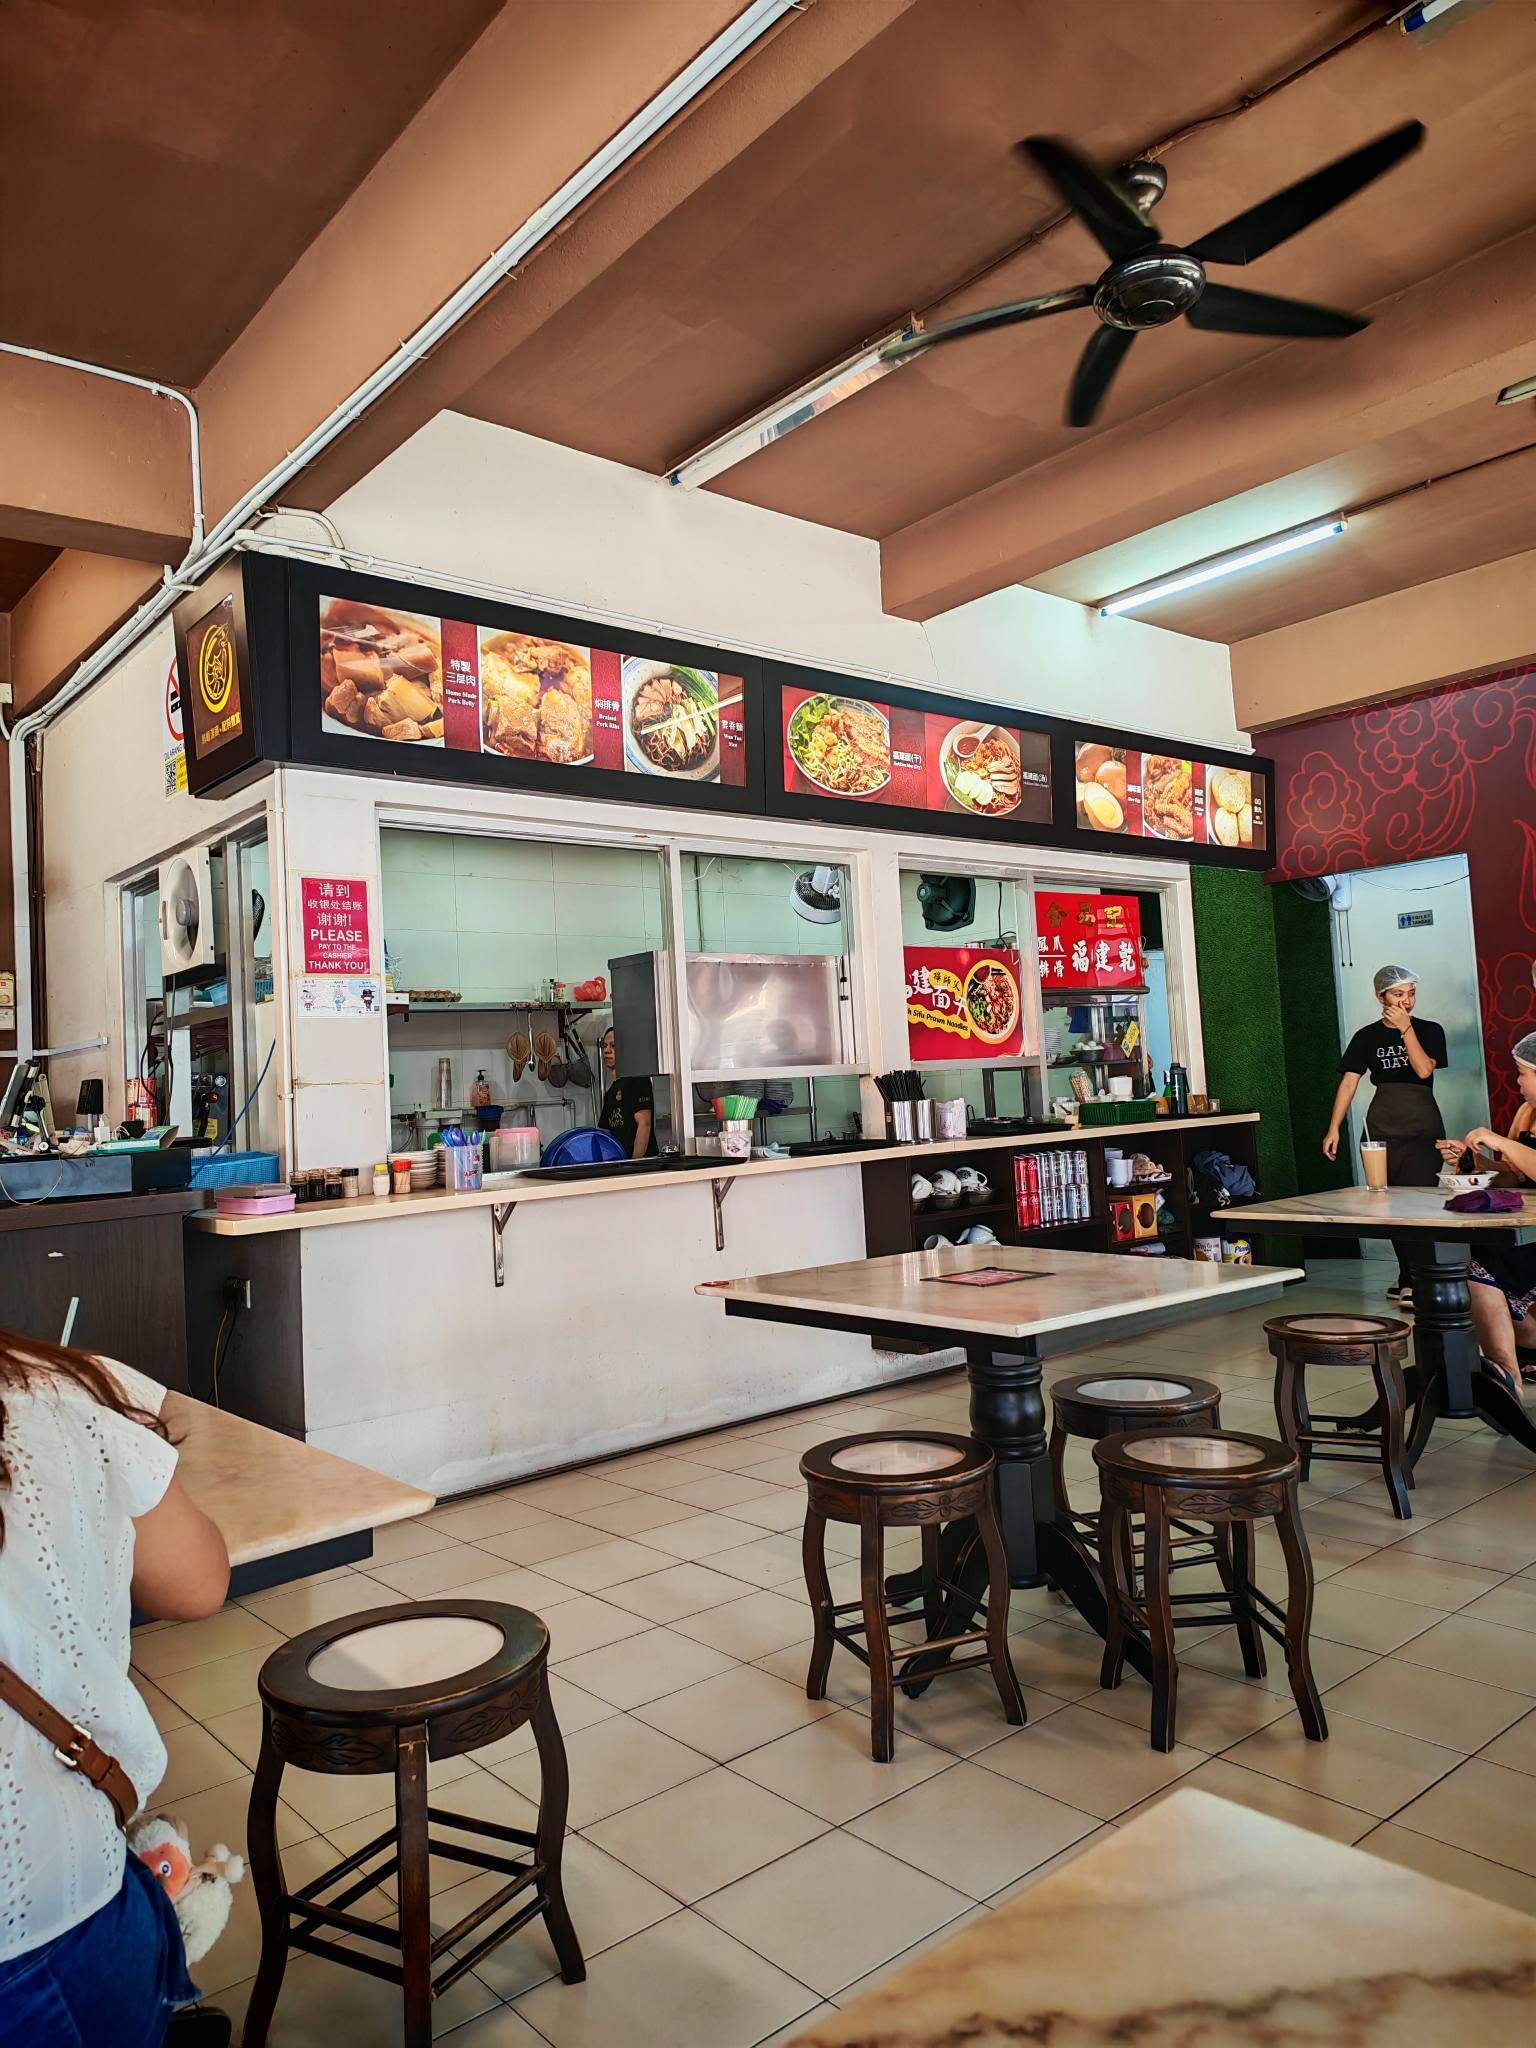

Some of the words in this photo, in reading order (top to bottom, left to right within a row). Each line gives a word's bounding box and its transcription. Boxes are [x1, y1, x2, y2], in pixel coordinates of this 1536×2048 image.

[447, 697, 461, 705] Pork
[318, 882, 351, 898] 请到
[307, 898, 363, 911] 收银处结账
[317, 911, 353, 927] 谢谢!
[310, 928, 363, 942] PLEASE
[332, 943, 342, 951] TO
[342, 943, 357, 951] THE
[322, 952, 353, 960] CASHIER
[308, 960, 341, 970] THANK
[343, 961, 367, 971] YOU!
[926, 1013, 945, 1025] Prawn
[946, 1018, 968, 1031] Noodles
[1381, 1056, 1408, 1069] DAY
